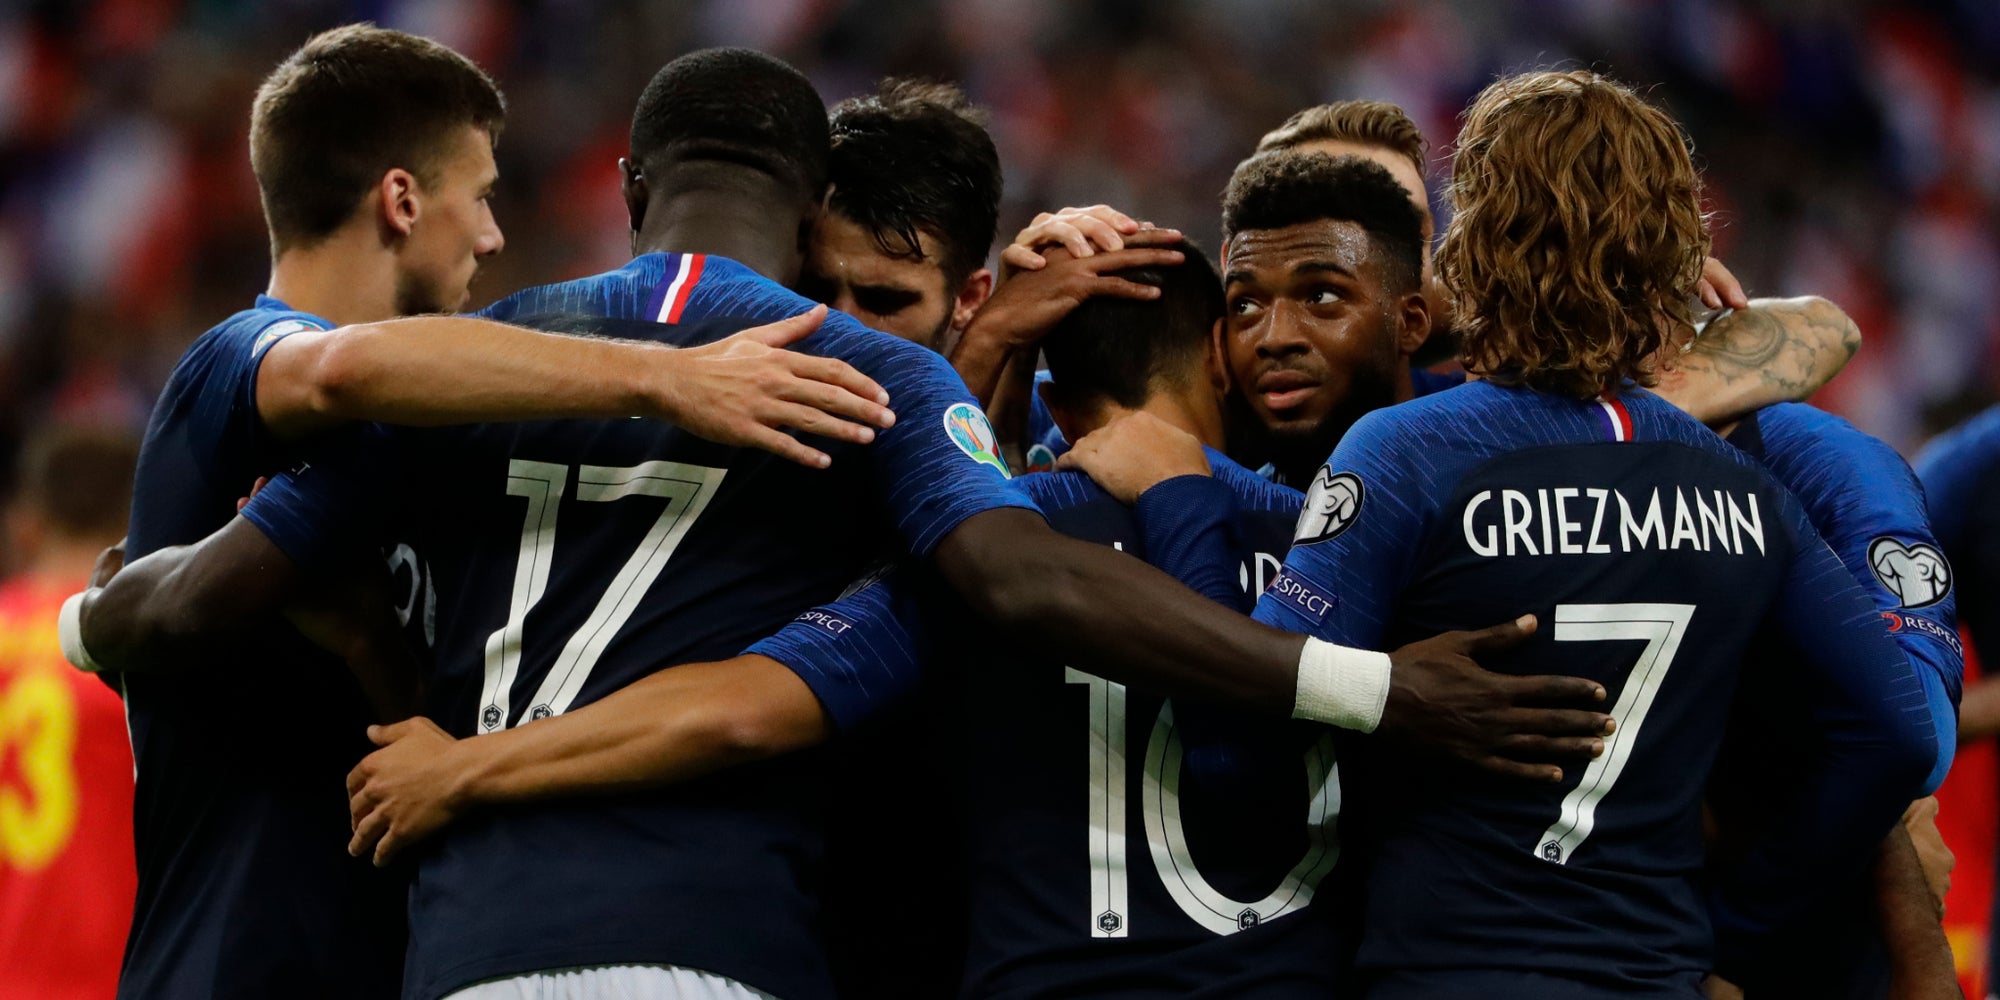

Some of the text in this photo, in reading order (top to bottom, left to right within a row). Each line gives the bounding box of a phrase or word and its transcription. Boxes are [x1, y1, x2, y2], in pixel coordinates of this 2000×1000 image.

[477, 458, 728, 735] 17
[1463, 485, 1765, 557] GRIEZMANN
[796, 611, 852, 634] SPECT
[1904, 616, 1964, 658] RESPECT
[1065, 665, 1342, 938] 10
[1533, 603, 1697, 865] 7
